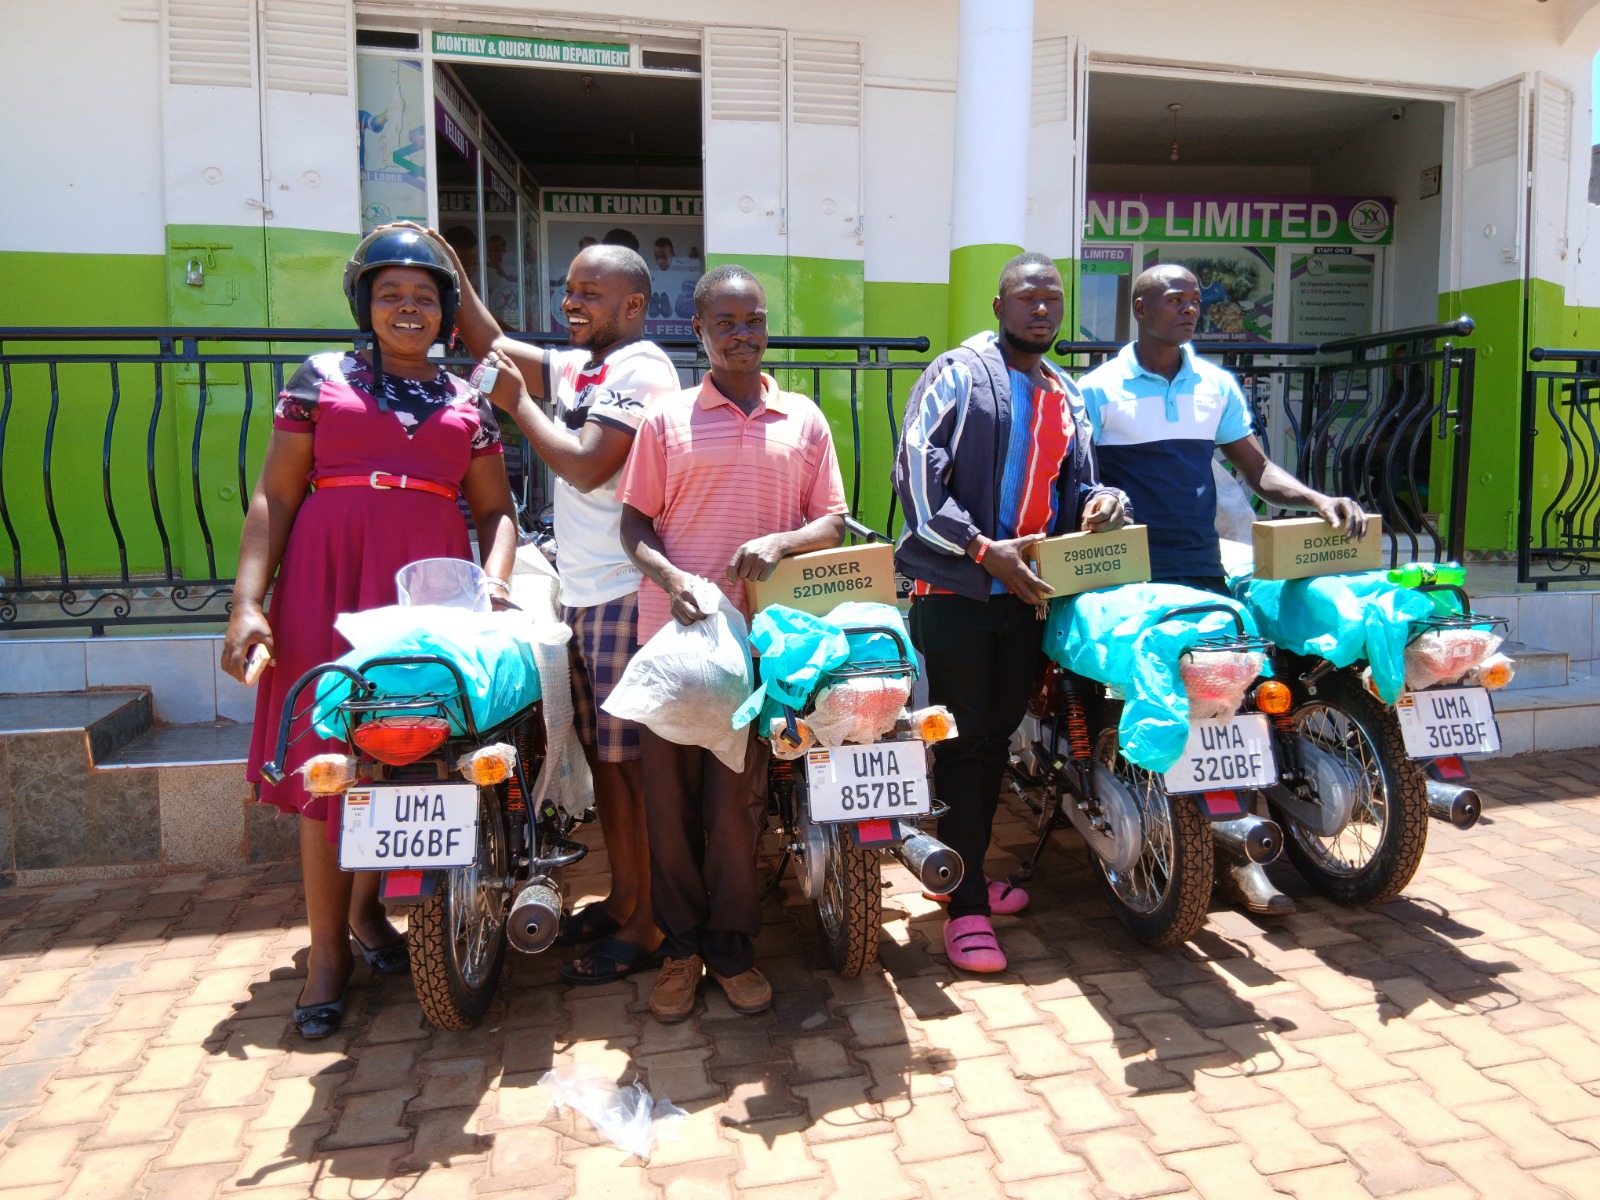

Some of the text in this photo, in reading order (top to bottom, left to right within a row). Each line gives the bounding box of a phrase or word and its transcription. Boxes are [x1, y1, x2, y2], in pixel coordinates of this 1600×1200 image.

[436, 35, 630, 66] MONTHLY & QUICK LOAN DEPARTMENT
[444, 113, 469, 159] TELLER 1
[374, 172, 402, 182] Loans
[491, 170, 507, 201] TELLER
[552, 194, 594, 213] KIN
[600, 195, 663, 214] FUND
[1087, 200, 1338, 239] ND LIMITED
[1084, 250, 1124, 260] LIMITED
[1091, 264, 1097, 272] 2
[656, 325, 693, 336] FEES
[1064, 543, 1128, 562] 52DM0862
[1304, 534, 1350, 549] BOXER
[1074, 559, 1121, 576] BOXER
[1295, 548, 1358, 565] 52DM0862
[802, 561, 861, 581] BOXER
[793, 576, 873, 599] 52DM0862
[1431, 696, 1472, 720] UMA
[1200, 724, 1245, 751] UMA
[1426, 722, 1487, 749] 305BF
[853, 750, 900, 778] UMA
[1191, 753, 1262, 783] 320BF
[841, 780, 918, 810] 857BE
[395, 794, 446, 822] UMA
[375, 828, 462, 858] 306BF
